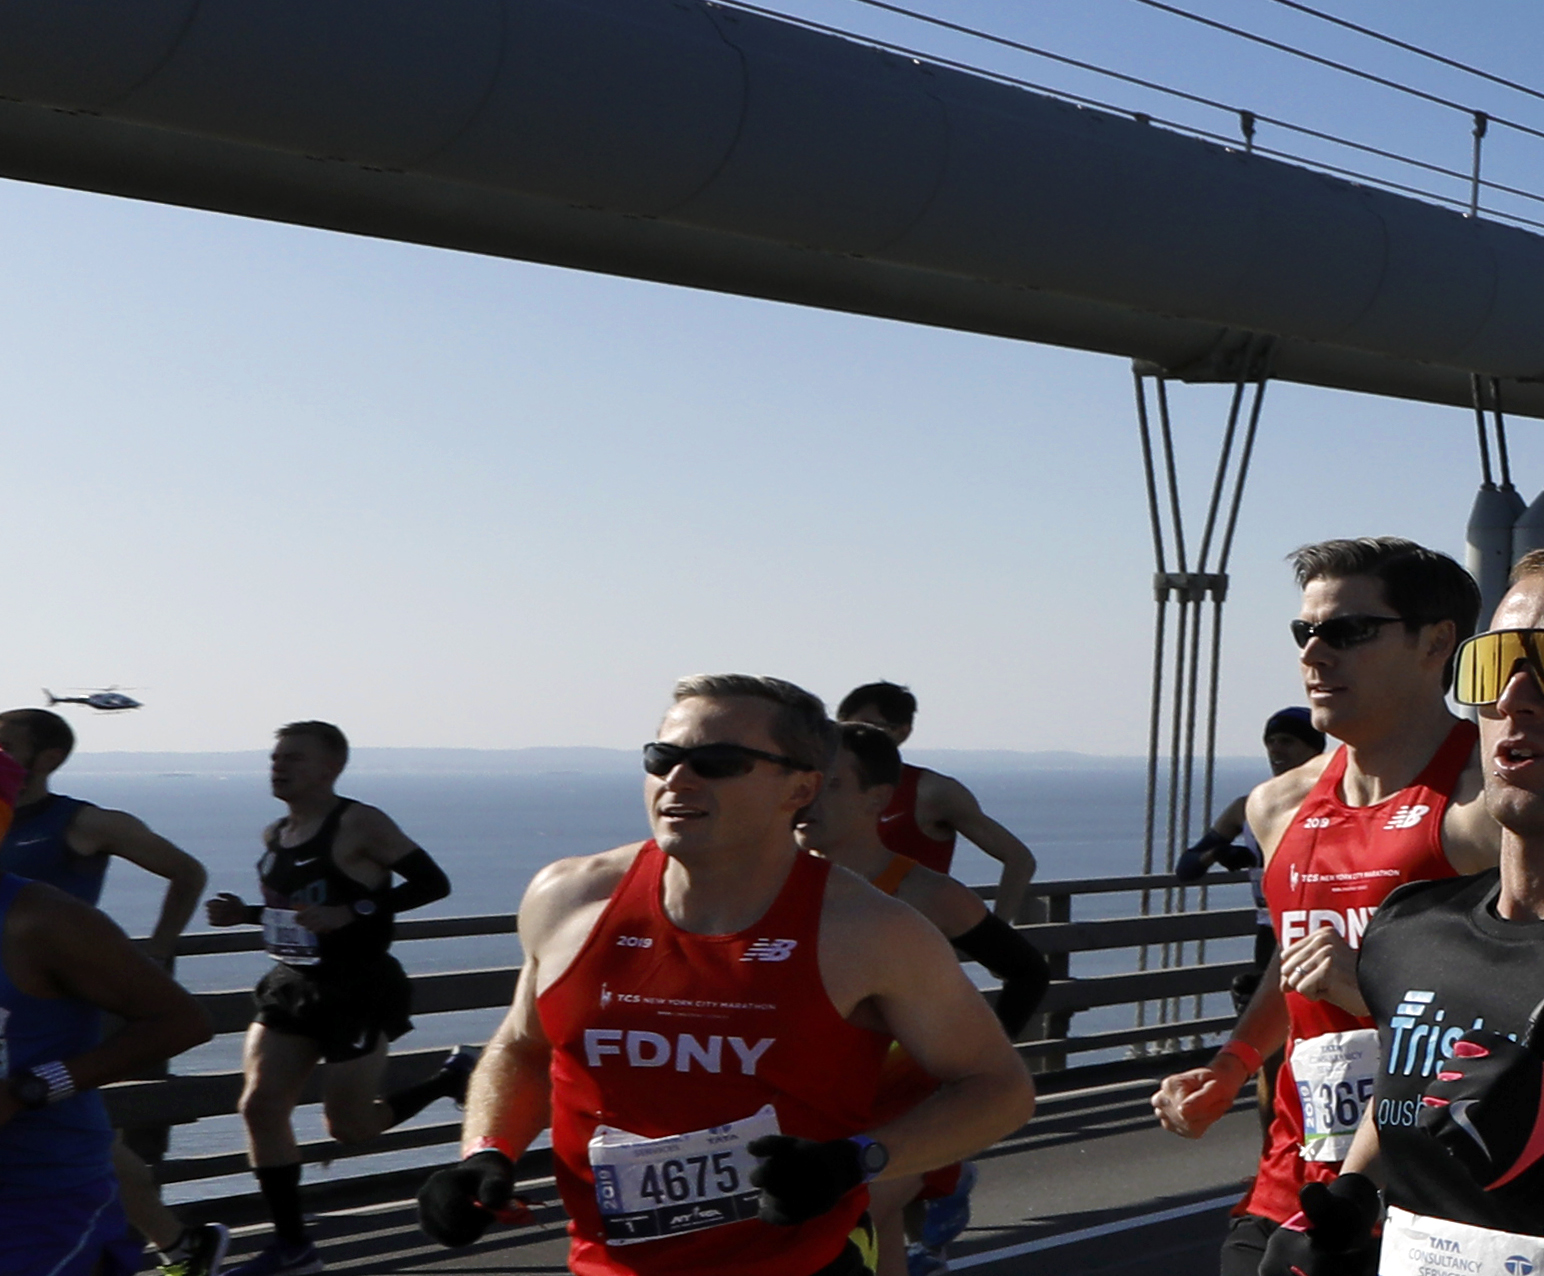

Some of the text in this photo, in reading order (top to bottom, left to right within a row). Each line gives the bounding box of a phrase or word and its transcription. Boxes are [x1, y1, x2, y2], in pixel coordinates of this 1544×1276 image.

[1302, 874, 1319, 882] TCS
[616, 936, 653, 948] 2019
[1282, 907, 1379, 951] FDN
[617, 994, 641, 1003] TCS
[695, 1000, 718, 1008] CITY
[720, 1001, 776, 1010] MARATHON
[584, 1028, 777, 1076] FDNY
[1299, 1085, 1316, 1128] 2019
[598, 1170, 618, 1210] 2019
[640, 1151, 739, 1204] 4675
[1408, 1247, 1483, 1274] CONSULTANCY
[1430, 1236, 1461, 1254] TATA
